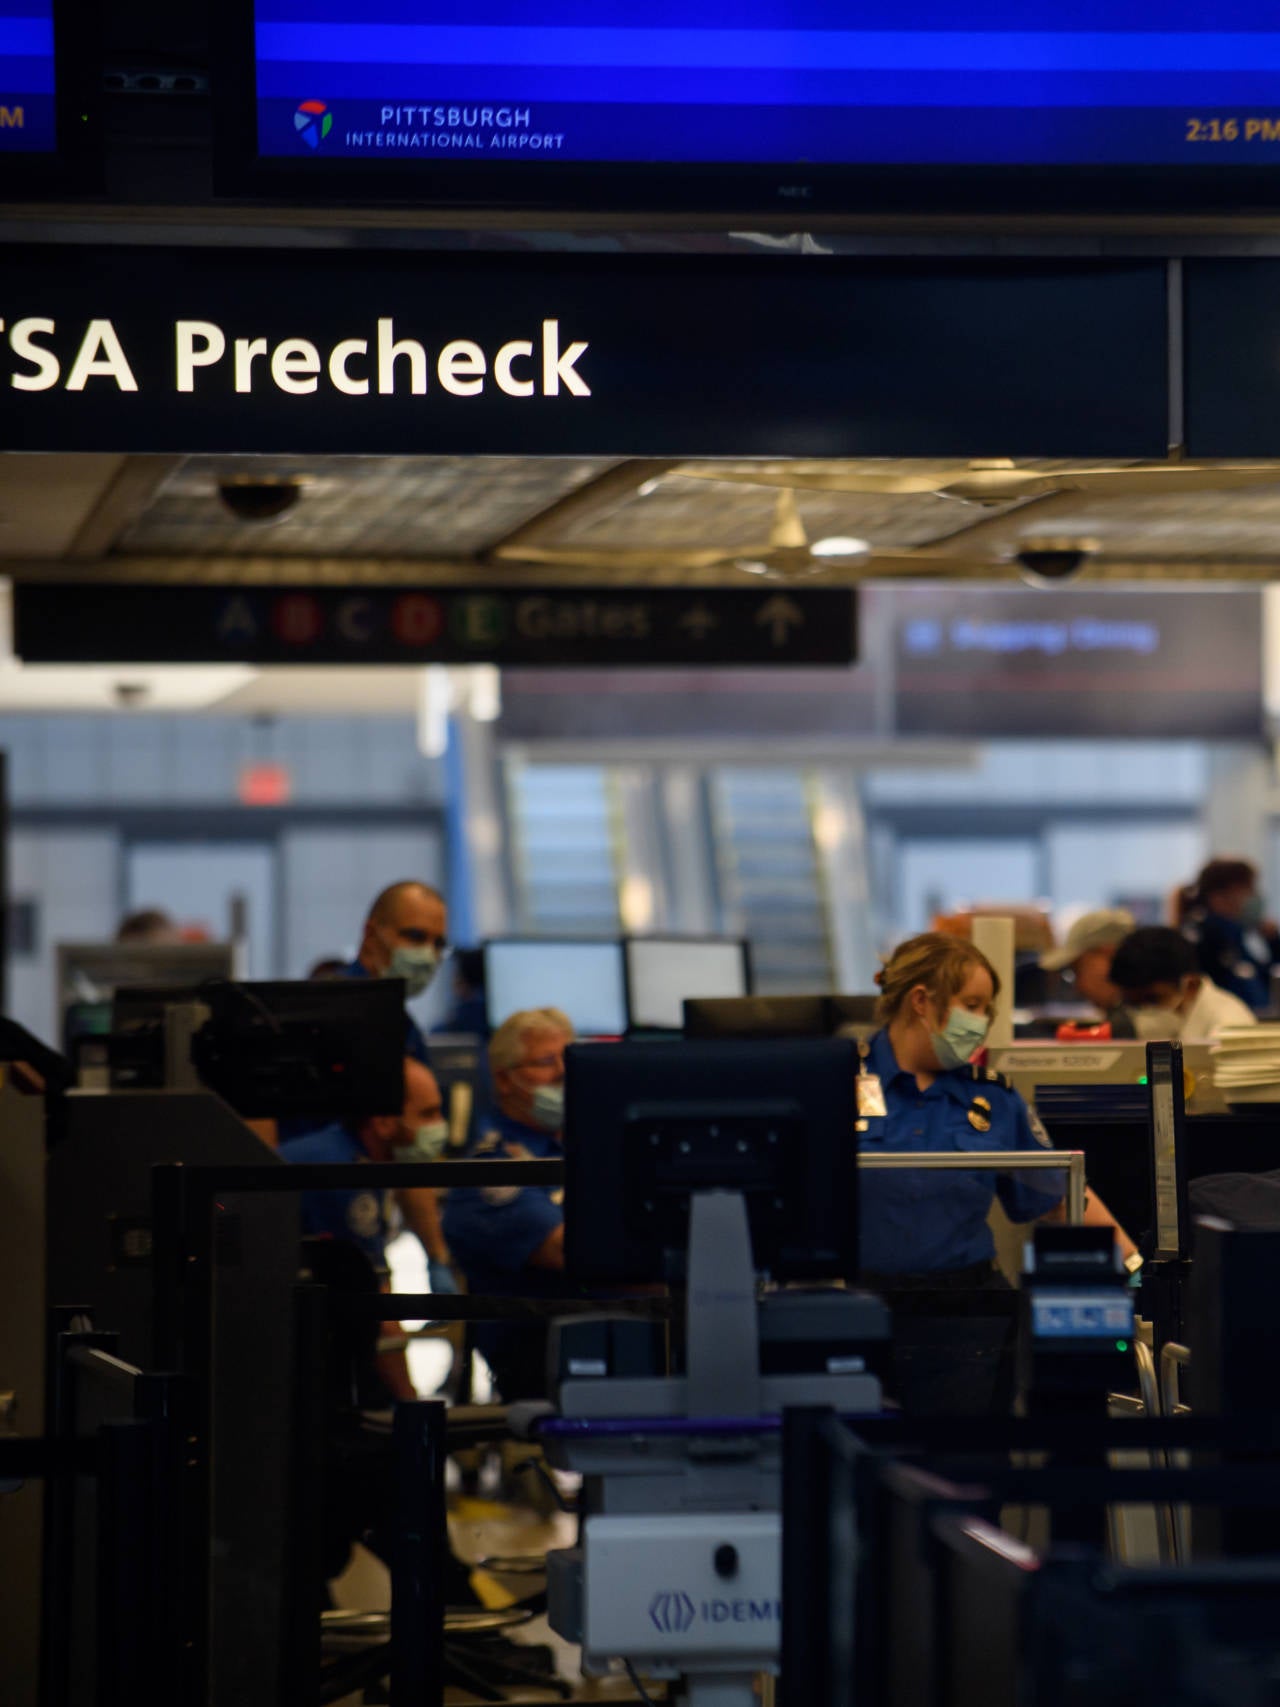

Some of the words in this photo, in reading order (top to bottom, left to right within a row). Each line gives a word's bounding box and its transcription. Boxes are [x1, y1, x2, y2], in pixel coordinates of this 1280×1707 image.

[381, 107, 530, 127] PITTSBURGH
[1186, 118, 1239, 141] 2:16
[346, 132, 484, 148] INTERNATIONAL
[490, 133, 565, 149] AIRPORT
[0, 317, 139, 392] SA
[175, 317, 592, 397] Precheck
